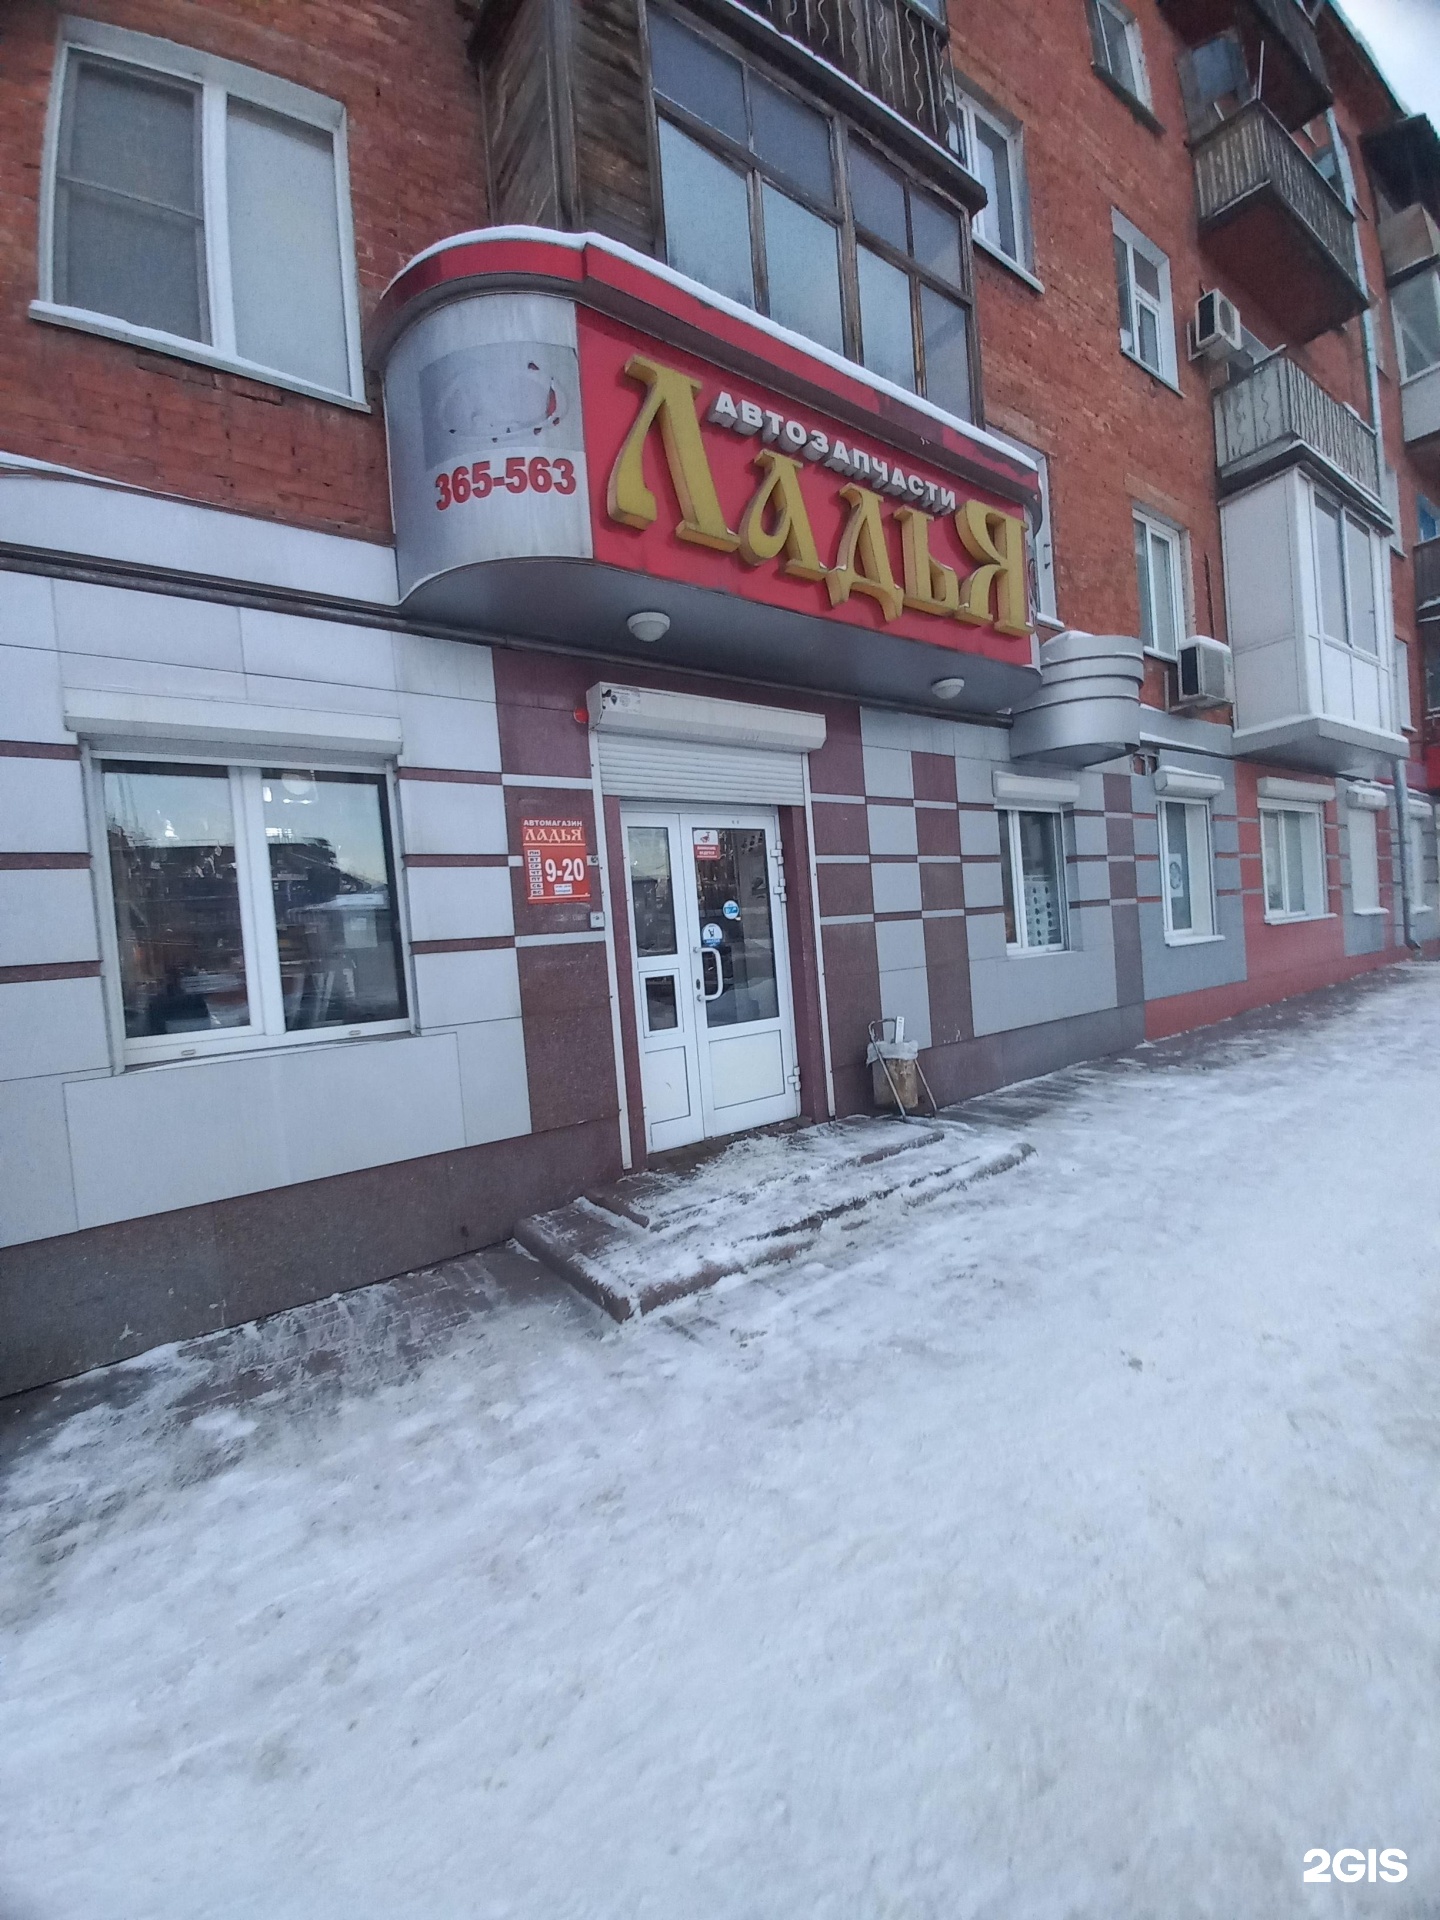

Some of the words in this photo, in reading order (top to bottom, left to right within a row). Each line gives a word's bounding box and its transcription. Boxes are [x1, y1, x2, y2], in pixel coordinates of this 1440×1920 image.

[708, 391, 957, 514] АВТОЗАПЧАСТИ
[435, 456, 577, 511] 365-563
[523, 819, 583, 827] АВТОМАГАЗИН
[545, 858, 585, 882] 9-20
